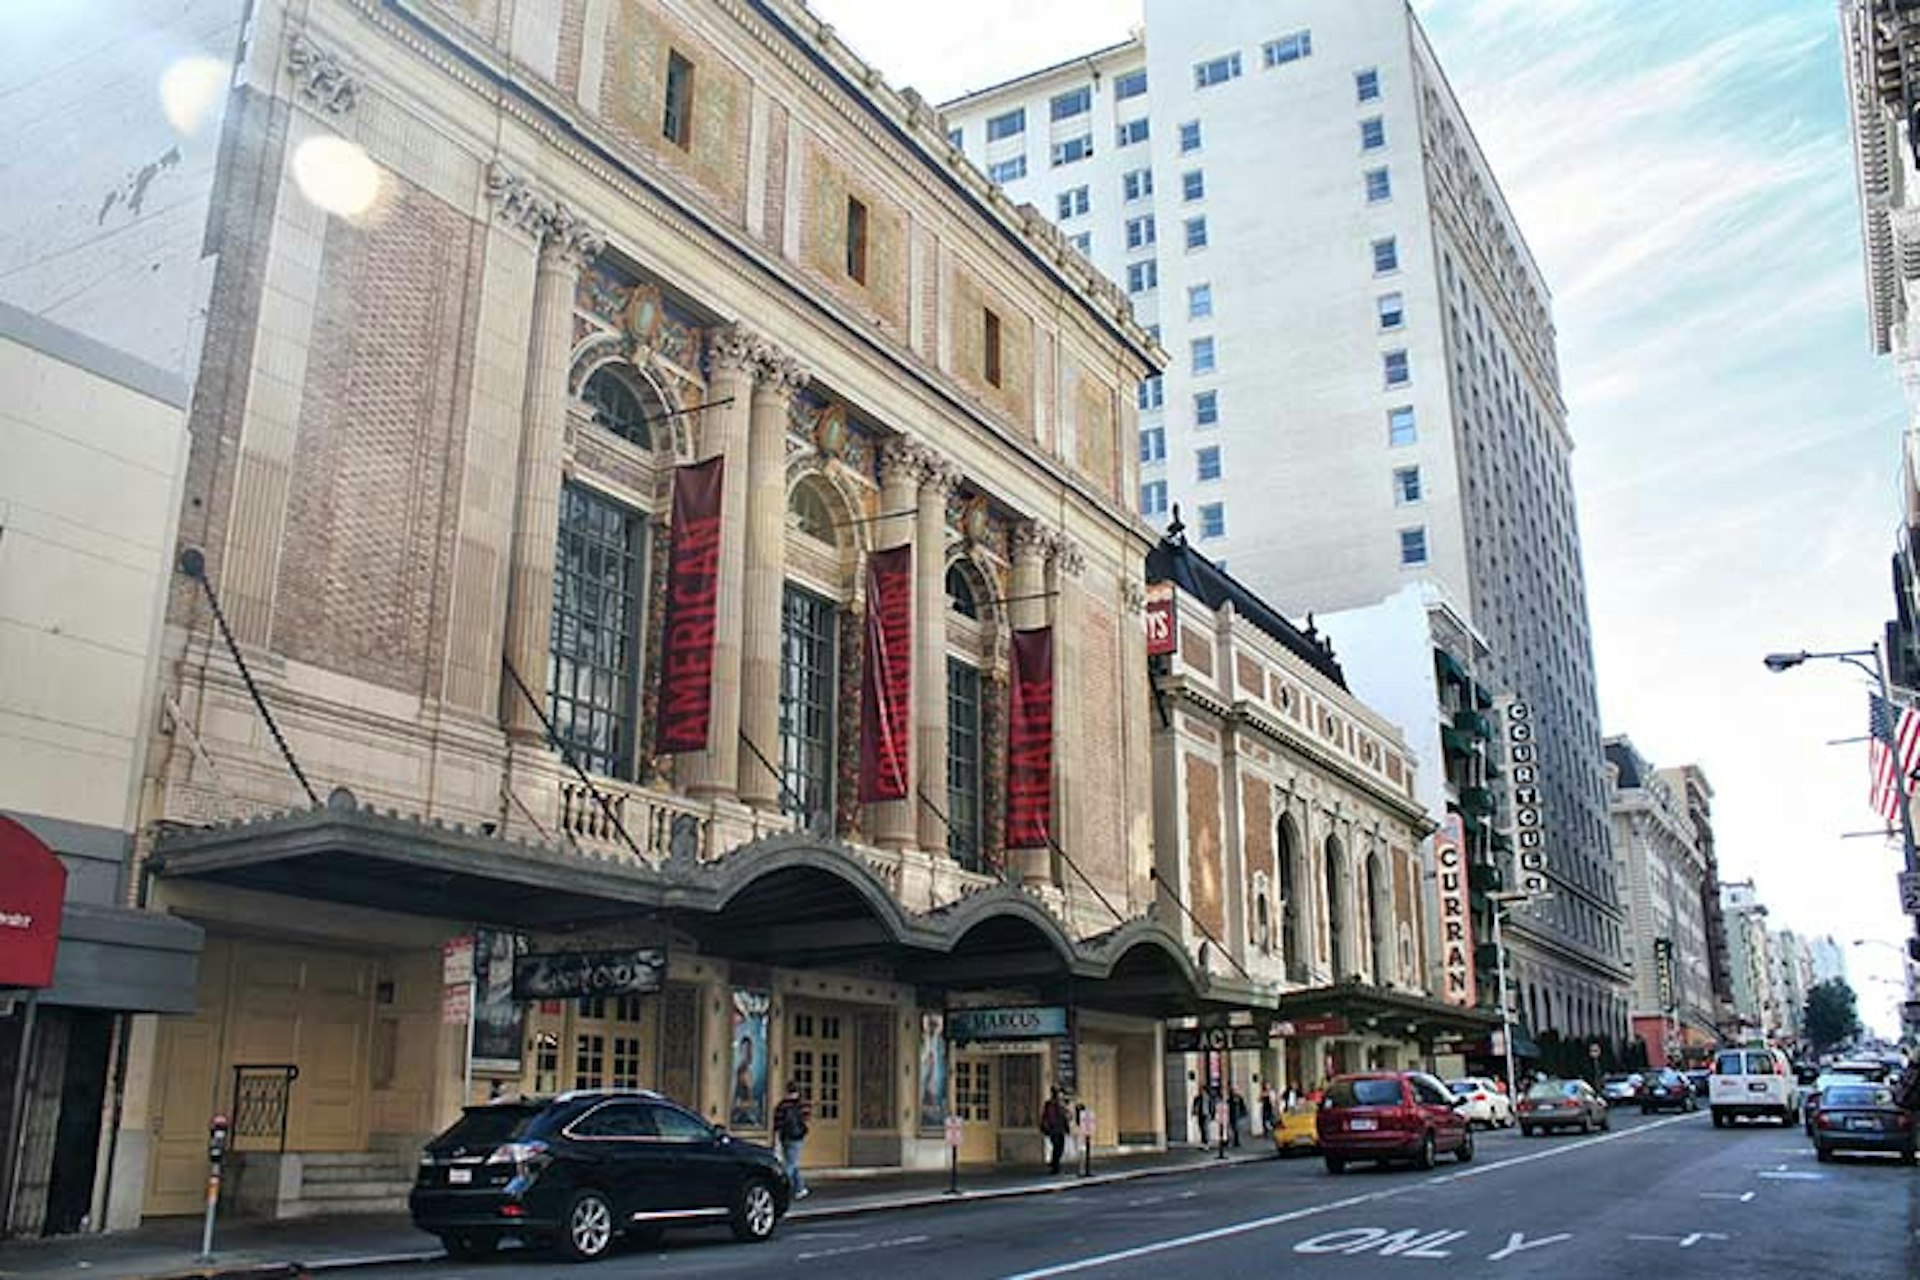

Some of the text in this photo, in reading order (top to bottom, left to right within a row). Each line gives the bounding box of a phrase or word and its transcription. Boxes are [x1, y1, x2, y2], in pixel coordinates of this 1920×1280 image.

[665, 516, 720, 742] AMERICAN
[1008, 678, 1053, 844] THEATER
[1440, 849, 1467, 991] CURRAN
